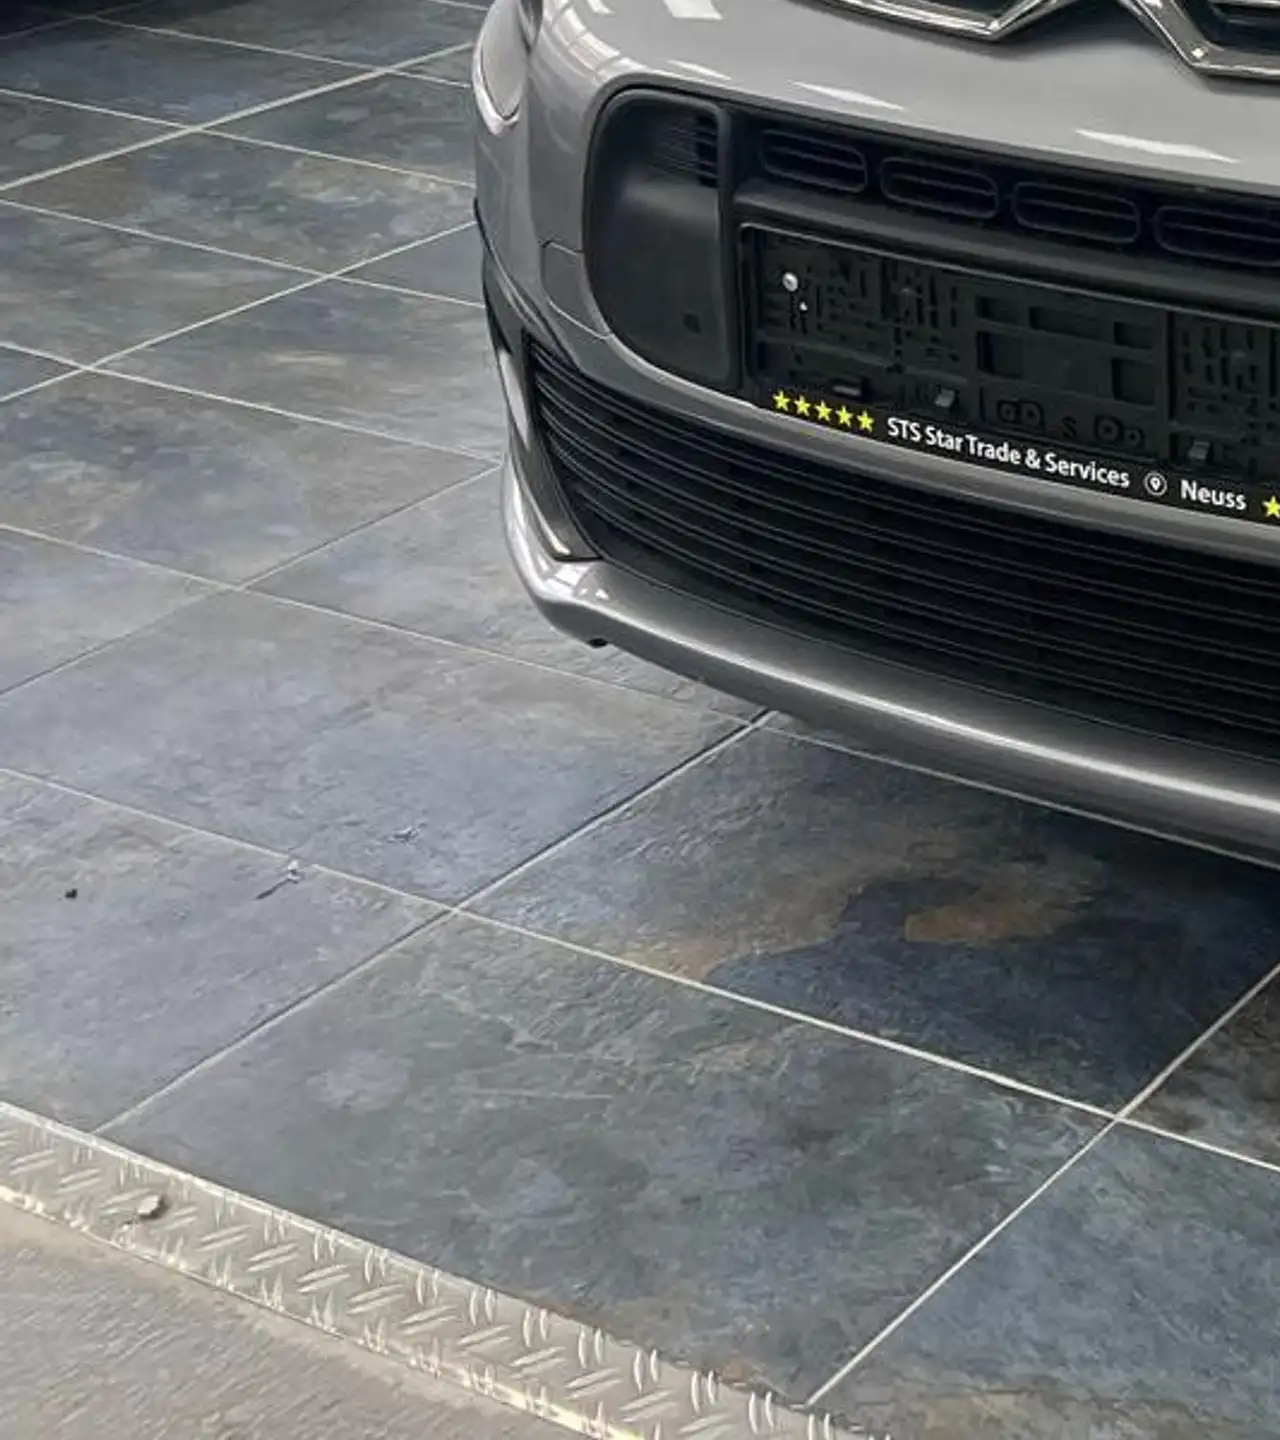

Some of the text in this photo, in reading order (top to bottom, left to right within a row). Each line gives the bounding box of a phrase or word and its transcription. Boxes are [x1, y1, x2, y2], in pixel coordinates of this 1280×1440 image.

[887, 417, 1247, 510] STS Star Trade & Services Neuss
